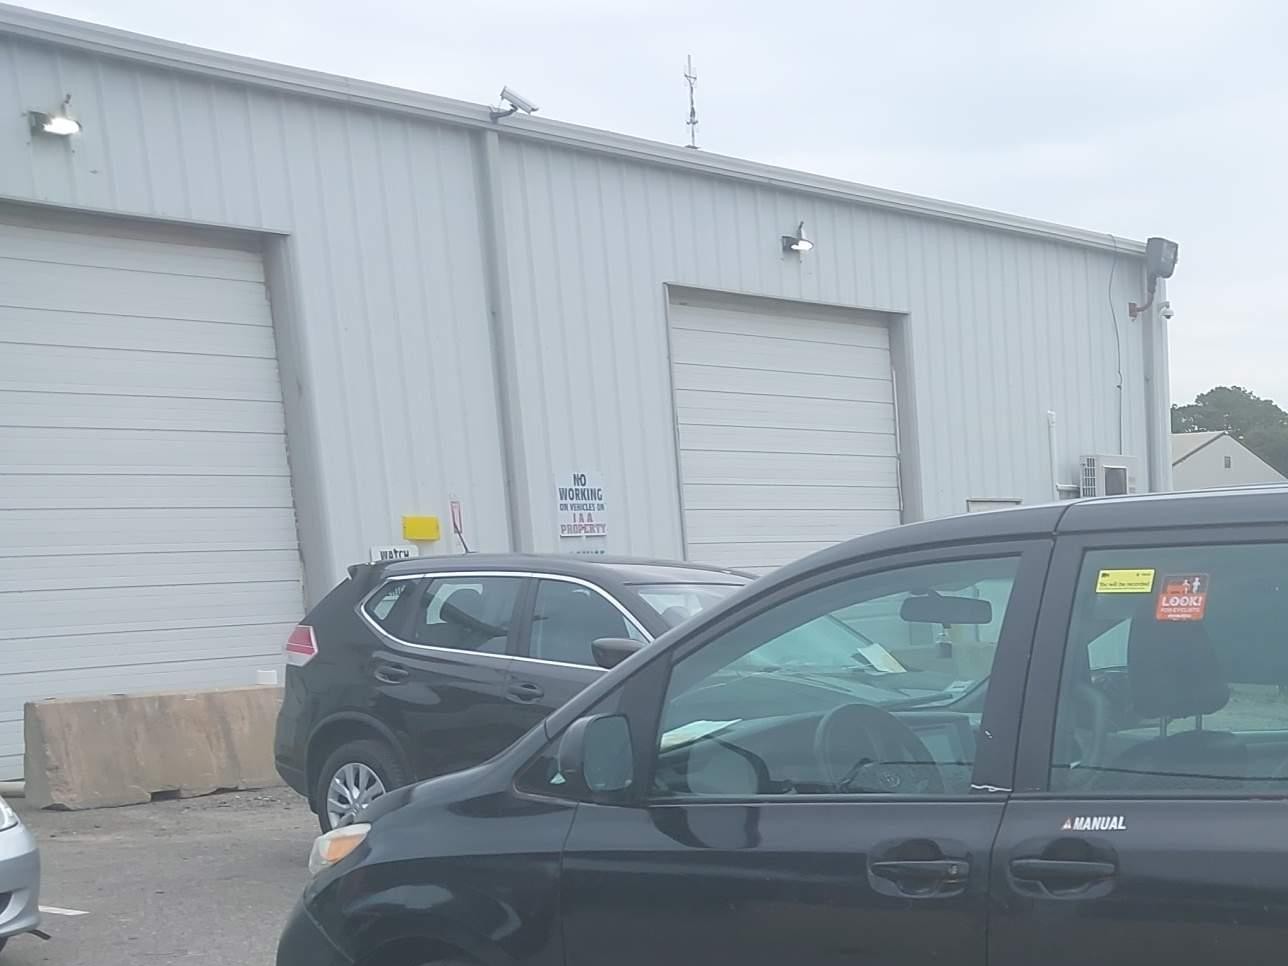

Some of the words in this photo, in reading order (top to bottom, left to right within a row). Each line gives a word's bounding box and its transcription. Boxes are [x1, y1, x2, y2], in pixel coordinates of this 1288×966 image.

[573, 473, 587, 487] NO
[558, 487, 603, 501] WORKING
[570, 503, 595, 511] VEHICLES
[560, 523, 607, 534] PROPERTY
[1073, 816, 1127, 831] MANUAL
